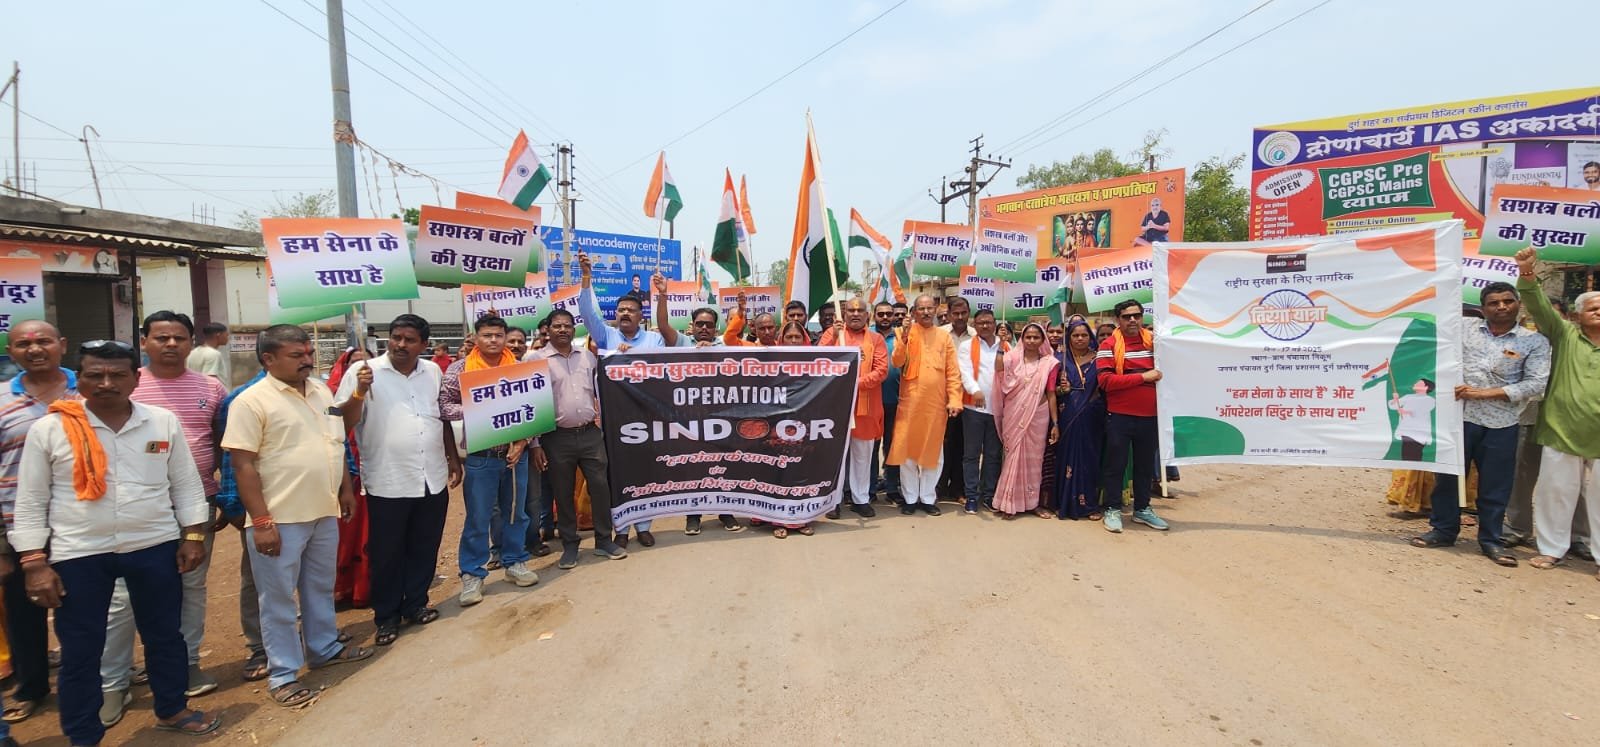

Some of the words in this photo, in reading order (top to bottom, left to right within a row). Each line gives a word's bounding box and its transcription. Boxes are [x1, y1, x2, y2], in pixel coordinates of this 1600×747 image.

[1362, 118, 1378, 127] शहर
[1431, 108, 1464, 118] डिजिटल
[1305, 126, 1416, 159] द्रोणाचार्य
[1424, 121, 1480, 143] IAS
[1264, 171, 1303, 191] ADMISSION
[1328, 166, 1387, 188] CGPSC
[1393, 163, 1423, 177] Pre
[1511, 172, 1562, 180] FUNDAMENTAL
[1273, 180, 1301, 197] OPEN
[1328, 183, 1374, 200] CGPSC
[1379, 178, 1422, 192] Mains
[996, 200, 1024, 214] भगवान
[1058, 190, 1091, 205] महायज्ञ
[1093, 190, 1099, 201] व
[1342, 191, 1410, 209] व्यापम
[1500, 198, 1558, 216] सशस्त्र
[1336, 218, 1384, 228] Offline/Live
[1387, 216, 1416, 224] Online
[281, 236, 320, 254] हम
[324, 232, 372, 252] सेना
[376, 232, 399, 251] के
[429, 222, 485, 242] सशस्त्र
[488, 228, 527, 246] बलों
[1004, 231, 1016, 240] बलों
[1498, 224, 1528, 240] की
[1531, 228, 1586, 247] सुरक्षा
[947, 237, 970, 250] सिंदूर
[430, 248, 458, 266] की
[462, 254, 512, 272] सुरक्षा
[920, 252, 938, 261] साथ
[1010, 248, 1023, 258] बलों
[315, 268, 362, 286] साथ
[362, 264, 384, 284] है
[1042, 266, 1061, 282] की
[1084, 264, 1131, 281] ऑपरेशन
[1224, 277, 1249, 289] राष्ट्रीय
[1252, 277, 1277, 288] सुरक्षा
[1280, 275, 1290, 284] के
[1293, 274, 1312, 284] लिए
[1316, 272, 1354, 282] नागरिक
[0, 280, 38, 304] ंदूर
[519, 286, 546, 299] सिंदूर
[1094, 285, 1106, 296] के
[1108, 282, 1130, 294] साथ
[1014, 292, 1044, 308] जीत
[671, 309, 688, 317] साथ
[1249, 306, 1290, 325] तिरंगा
[1290, 306, 1328, 322] यात्रा
[606, 360, 664, 382] राष्ट्रीय
[667, 361, 717, 382] सुरक्षा
[720, 358, 739, 377] के
[742, 360, 780, 377] लिए
[782, 358, 851, 377] नागरिक
[1264, 364, 1274, 374] दुर्ग
[1276, 364, 1292, 372] जिला
[1323, 364, 1334, 374] दुर्ग
[472, 385, 495, 402] हम
[500, 377, 528, 397] सेना
[531, 372, 546, 390] के
[673, 386, 788, 406] OPERATION
[1251, 386, 1274, 400] सेना
[1276, 386, 1287, 399] के
[1290, 388, 1314, 399] साथ
[1332, 386, 1355, 400] और
[492, 410, 522, 428] साथ
[522, 404, 534, 422] है
[1296, 406, 1307, 418] के
[1309, 408, 1335, 418] साथ
[689, 450, 724, 464] सेना
[724, 450, 742, 462] के
[742, 452, 778, 466] साथ
[700, 476, 738, 491] सिंदूर
[739, 478, 756, 490] के
[756, 481, 790, 496] साथ
[613, 504, 646, 520] जनपद
[649, 498, 688, 509] पंचायत
[716, 494, 746, 506] जिला
[748, 498, 784, 513] प्रशासन
[788, 503, 804, 514] दुर्ग
